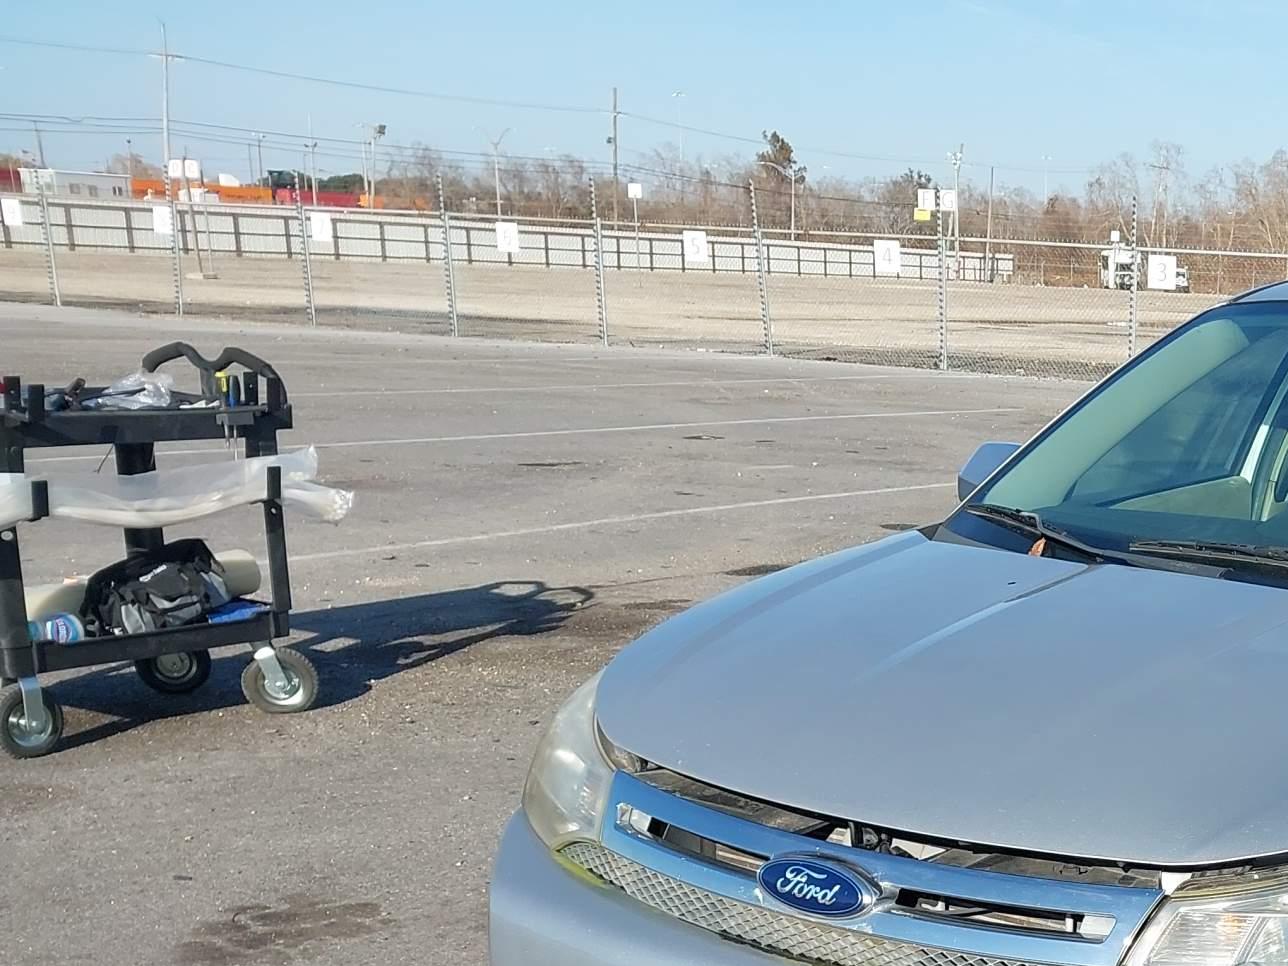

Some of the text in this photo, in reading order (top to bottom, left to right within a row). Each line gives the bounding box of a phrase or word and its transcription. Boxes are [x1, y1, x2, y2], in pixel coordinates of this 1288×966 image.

[921, 190, 954, 209] F G
[691, 236, 701, 255] 5
[882, 247, 892, 265] 4
[1157, 262, 1167, 282] 3
[776, 865, 841, 906] Ford
